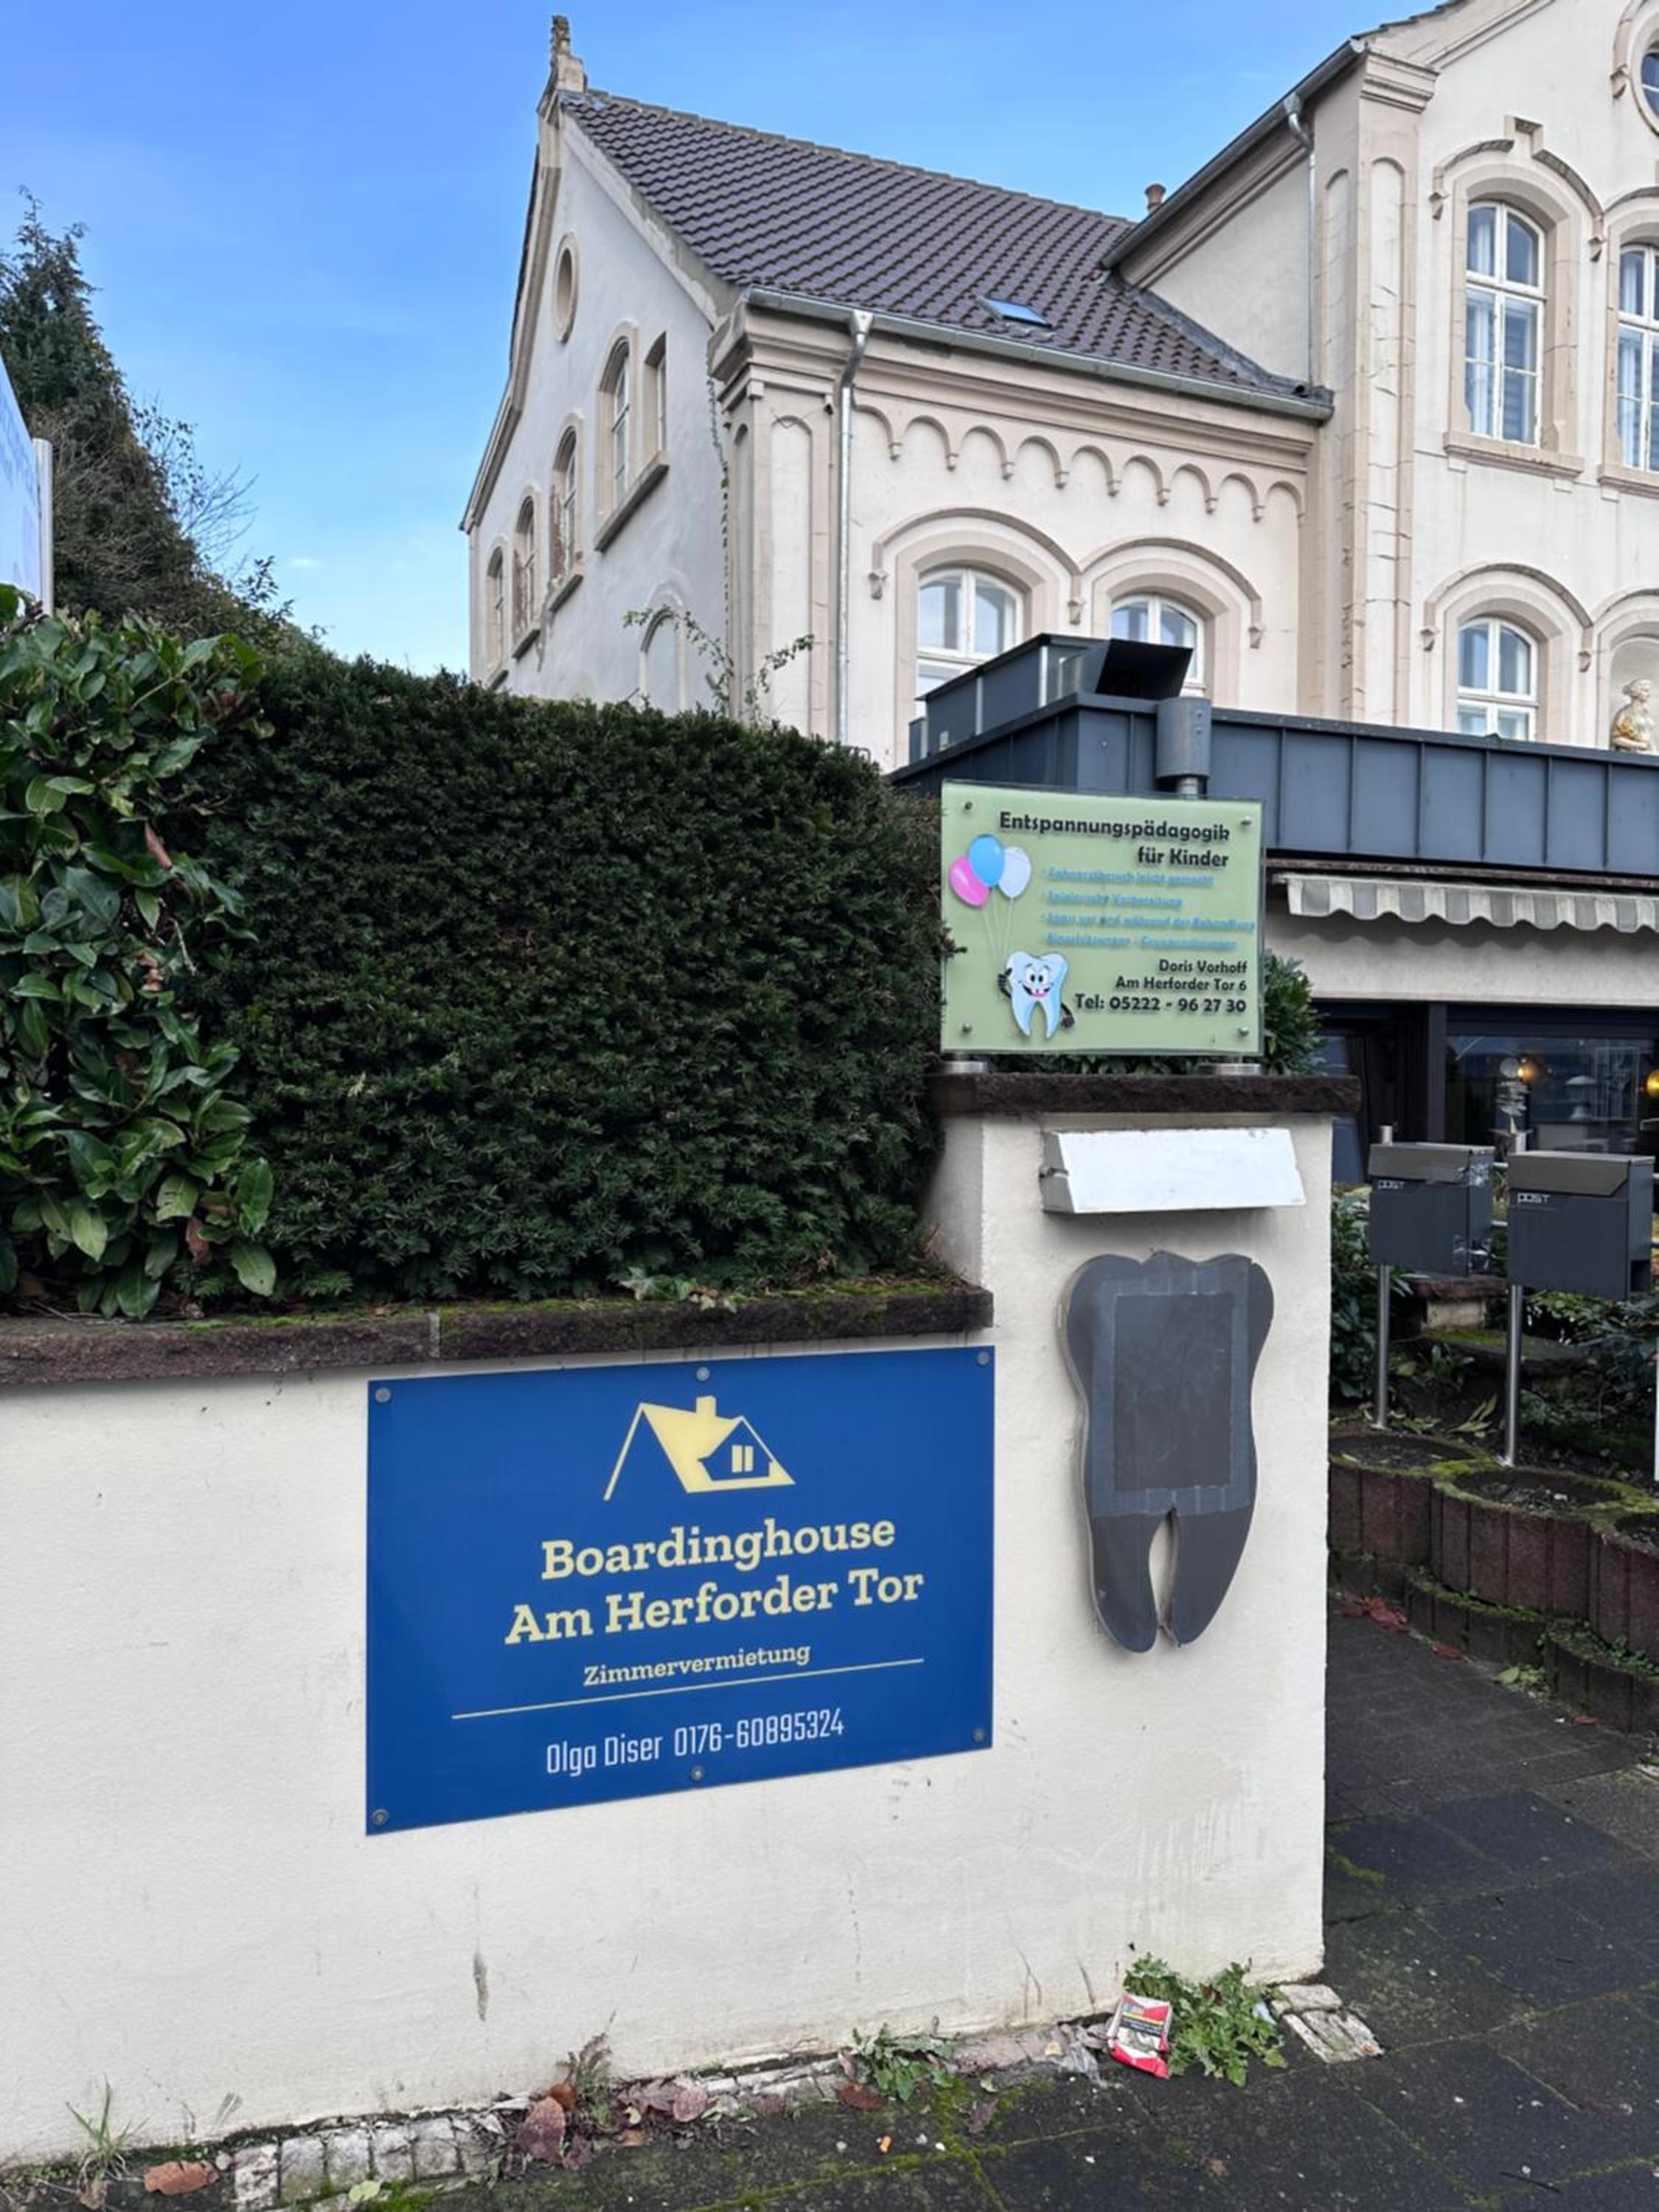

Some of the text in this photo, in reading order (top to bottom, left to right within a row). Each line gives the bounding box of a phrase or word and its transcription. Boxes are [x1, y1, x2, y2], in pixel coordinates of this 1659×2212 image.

[999, 812, 1230, 842] Entspannungspädagogik
[1138, 846, 1229, 868] für Kinder
[1158, 959, 1248, 974] Doris Vorhoff
[1115, 975, 1248, 992] Am Herforder Tor 6
[1075, 993, 1105, 1009] Tel:
[1109, 996, 1161, 1011] 05222
[1179, 998, 1199, 1012] 96
[1203, 999, 1222, 1012] 27
[1226, 999, 1247, 1013] 30
[541, 1517, 895, 1580] Boardinghouse
[504, 1568, 924, 1645] Am Herforder Tor
[583, 1645, 811, 1687] Zimmervermietung
[546, 1708, 844, 1778] Olga Diser 0176-60895324
